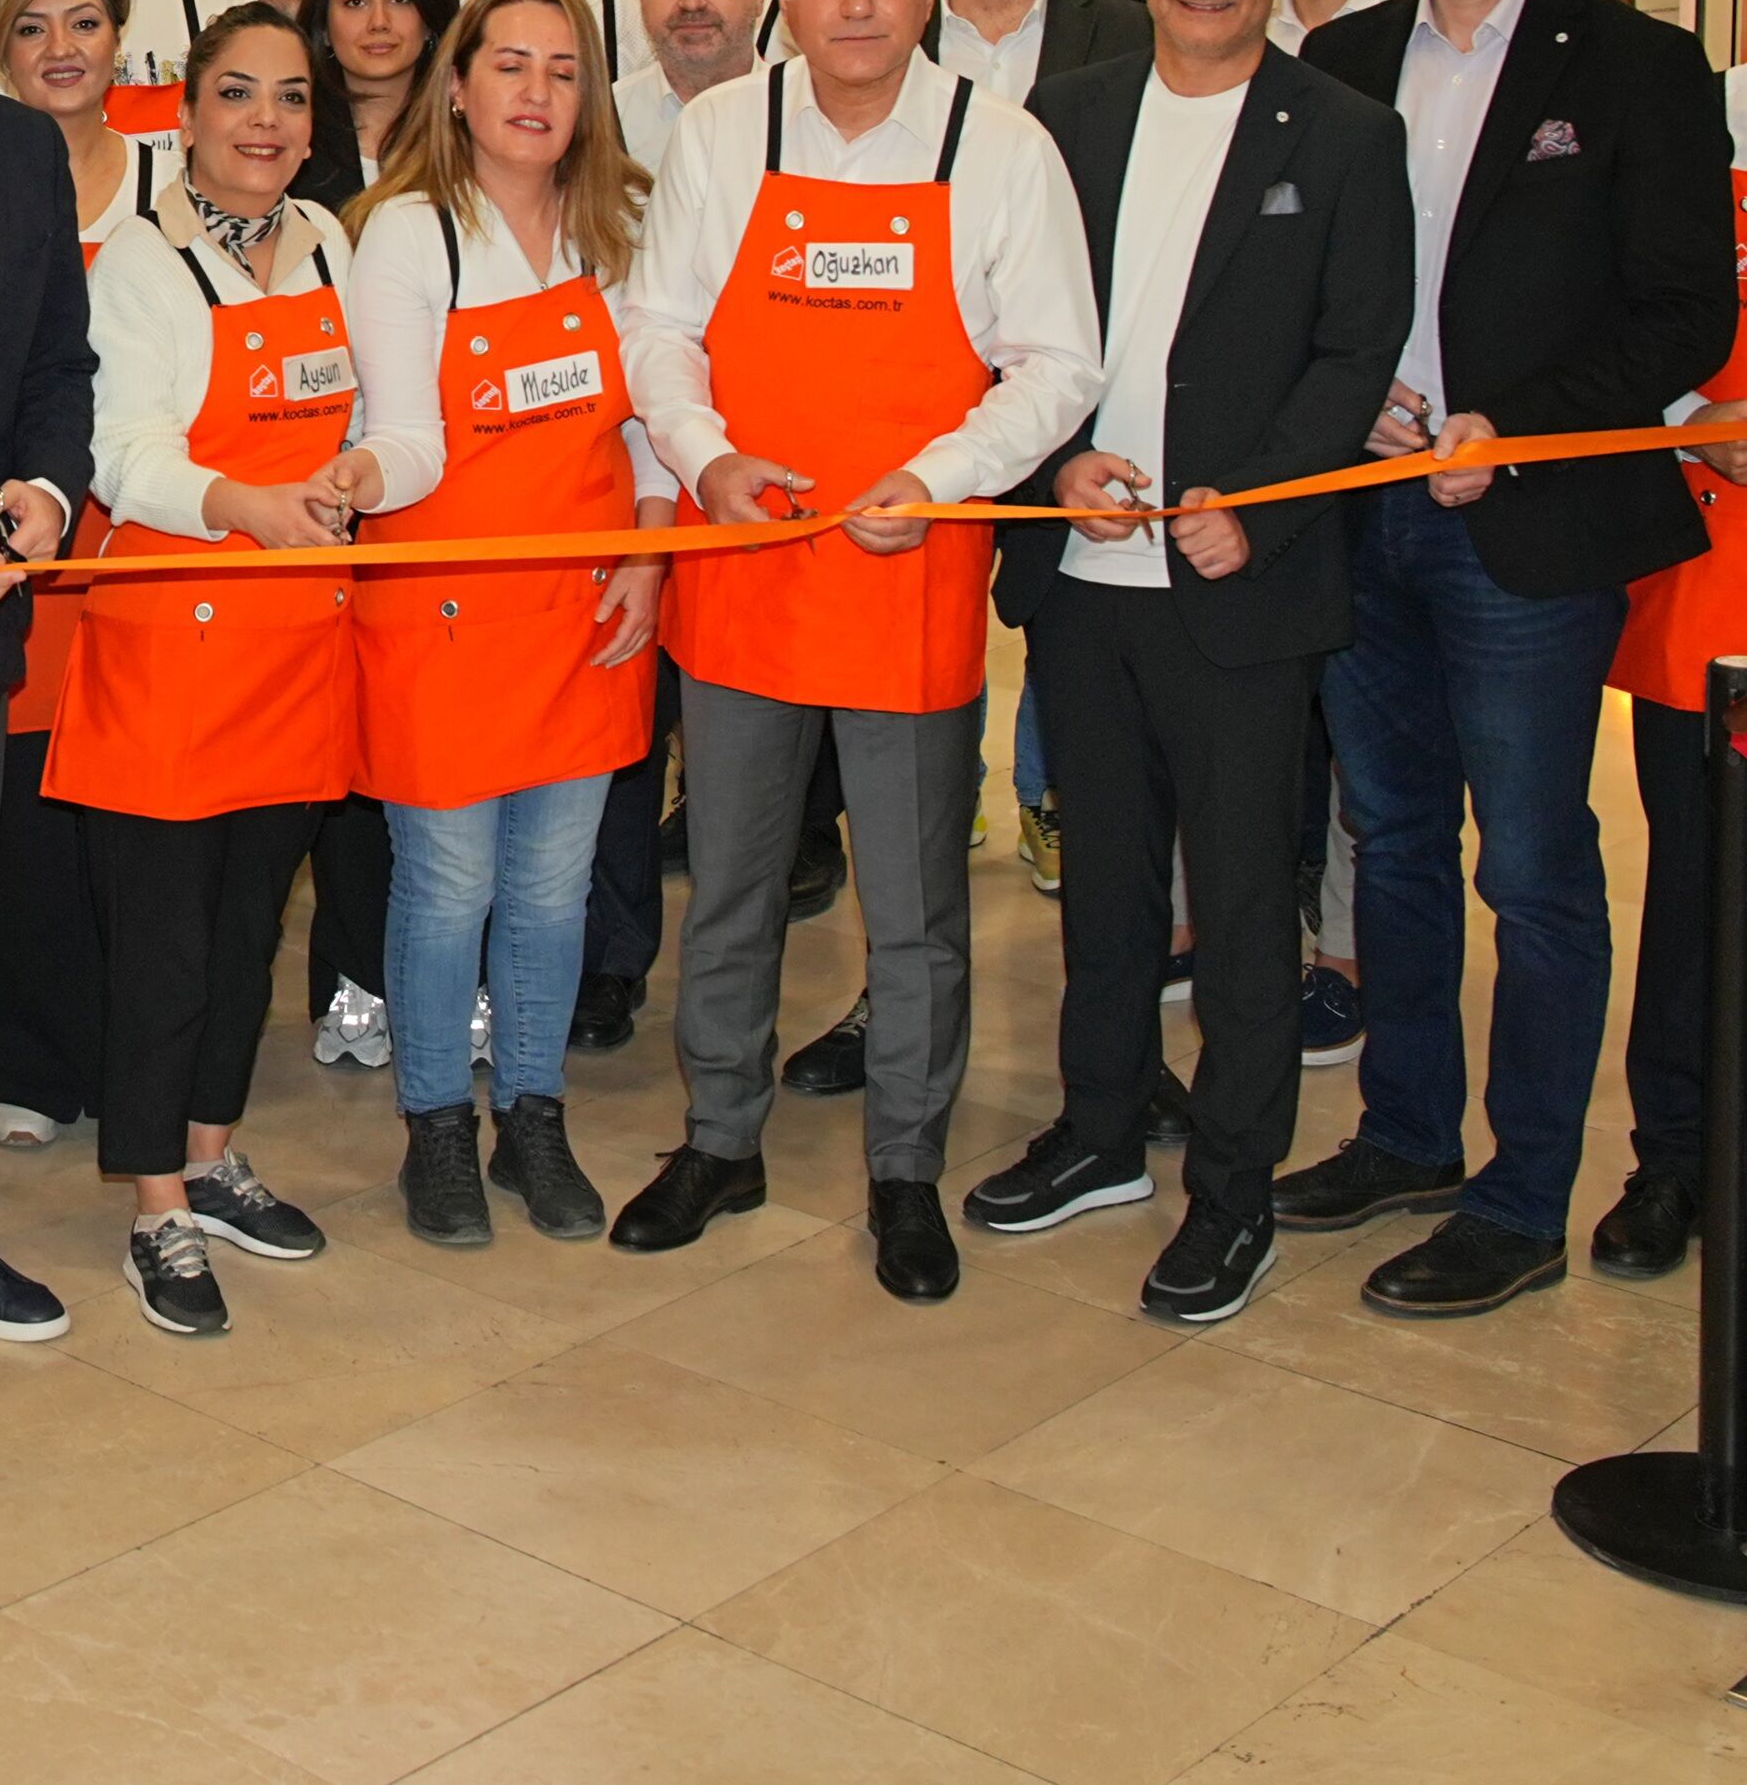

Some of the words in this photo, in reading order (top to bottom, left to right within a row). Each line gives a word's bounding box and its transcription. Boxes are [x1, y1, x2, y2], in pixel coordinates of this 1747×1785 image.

[812, 248, 900, 283] Oğuzkan
[768, 290, 904, 312] www.koctas.com.tr
[299, 362, 341, 393] Aysun
[521, 361, 589, 404] Mesude
[472, 402, 596, 434] www.koctas.com.tr
